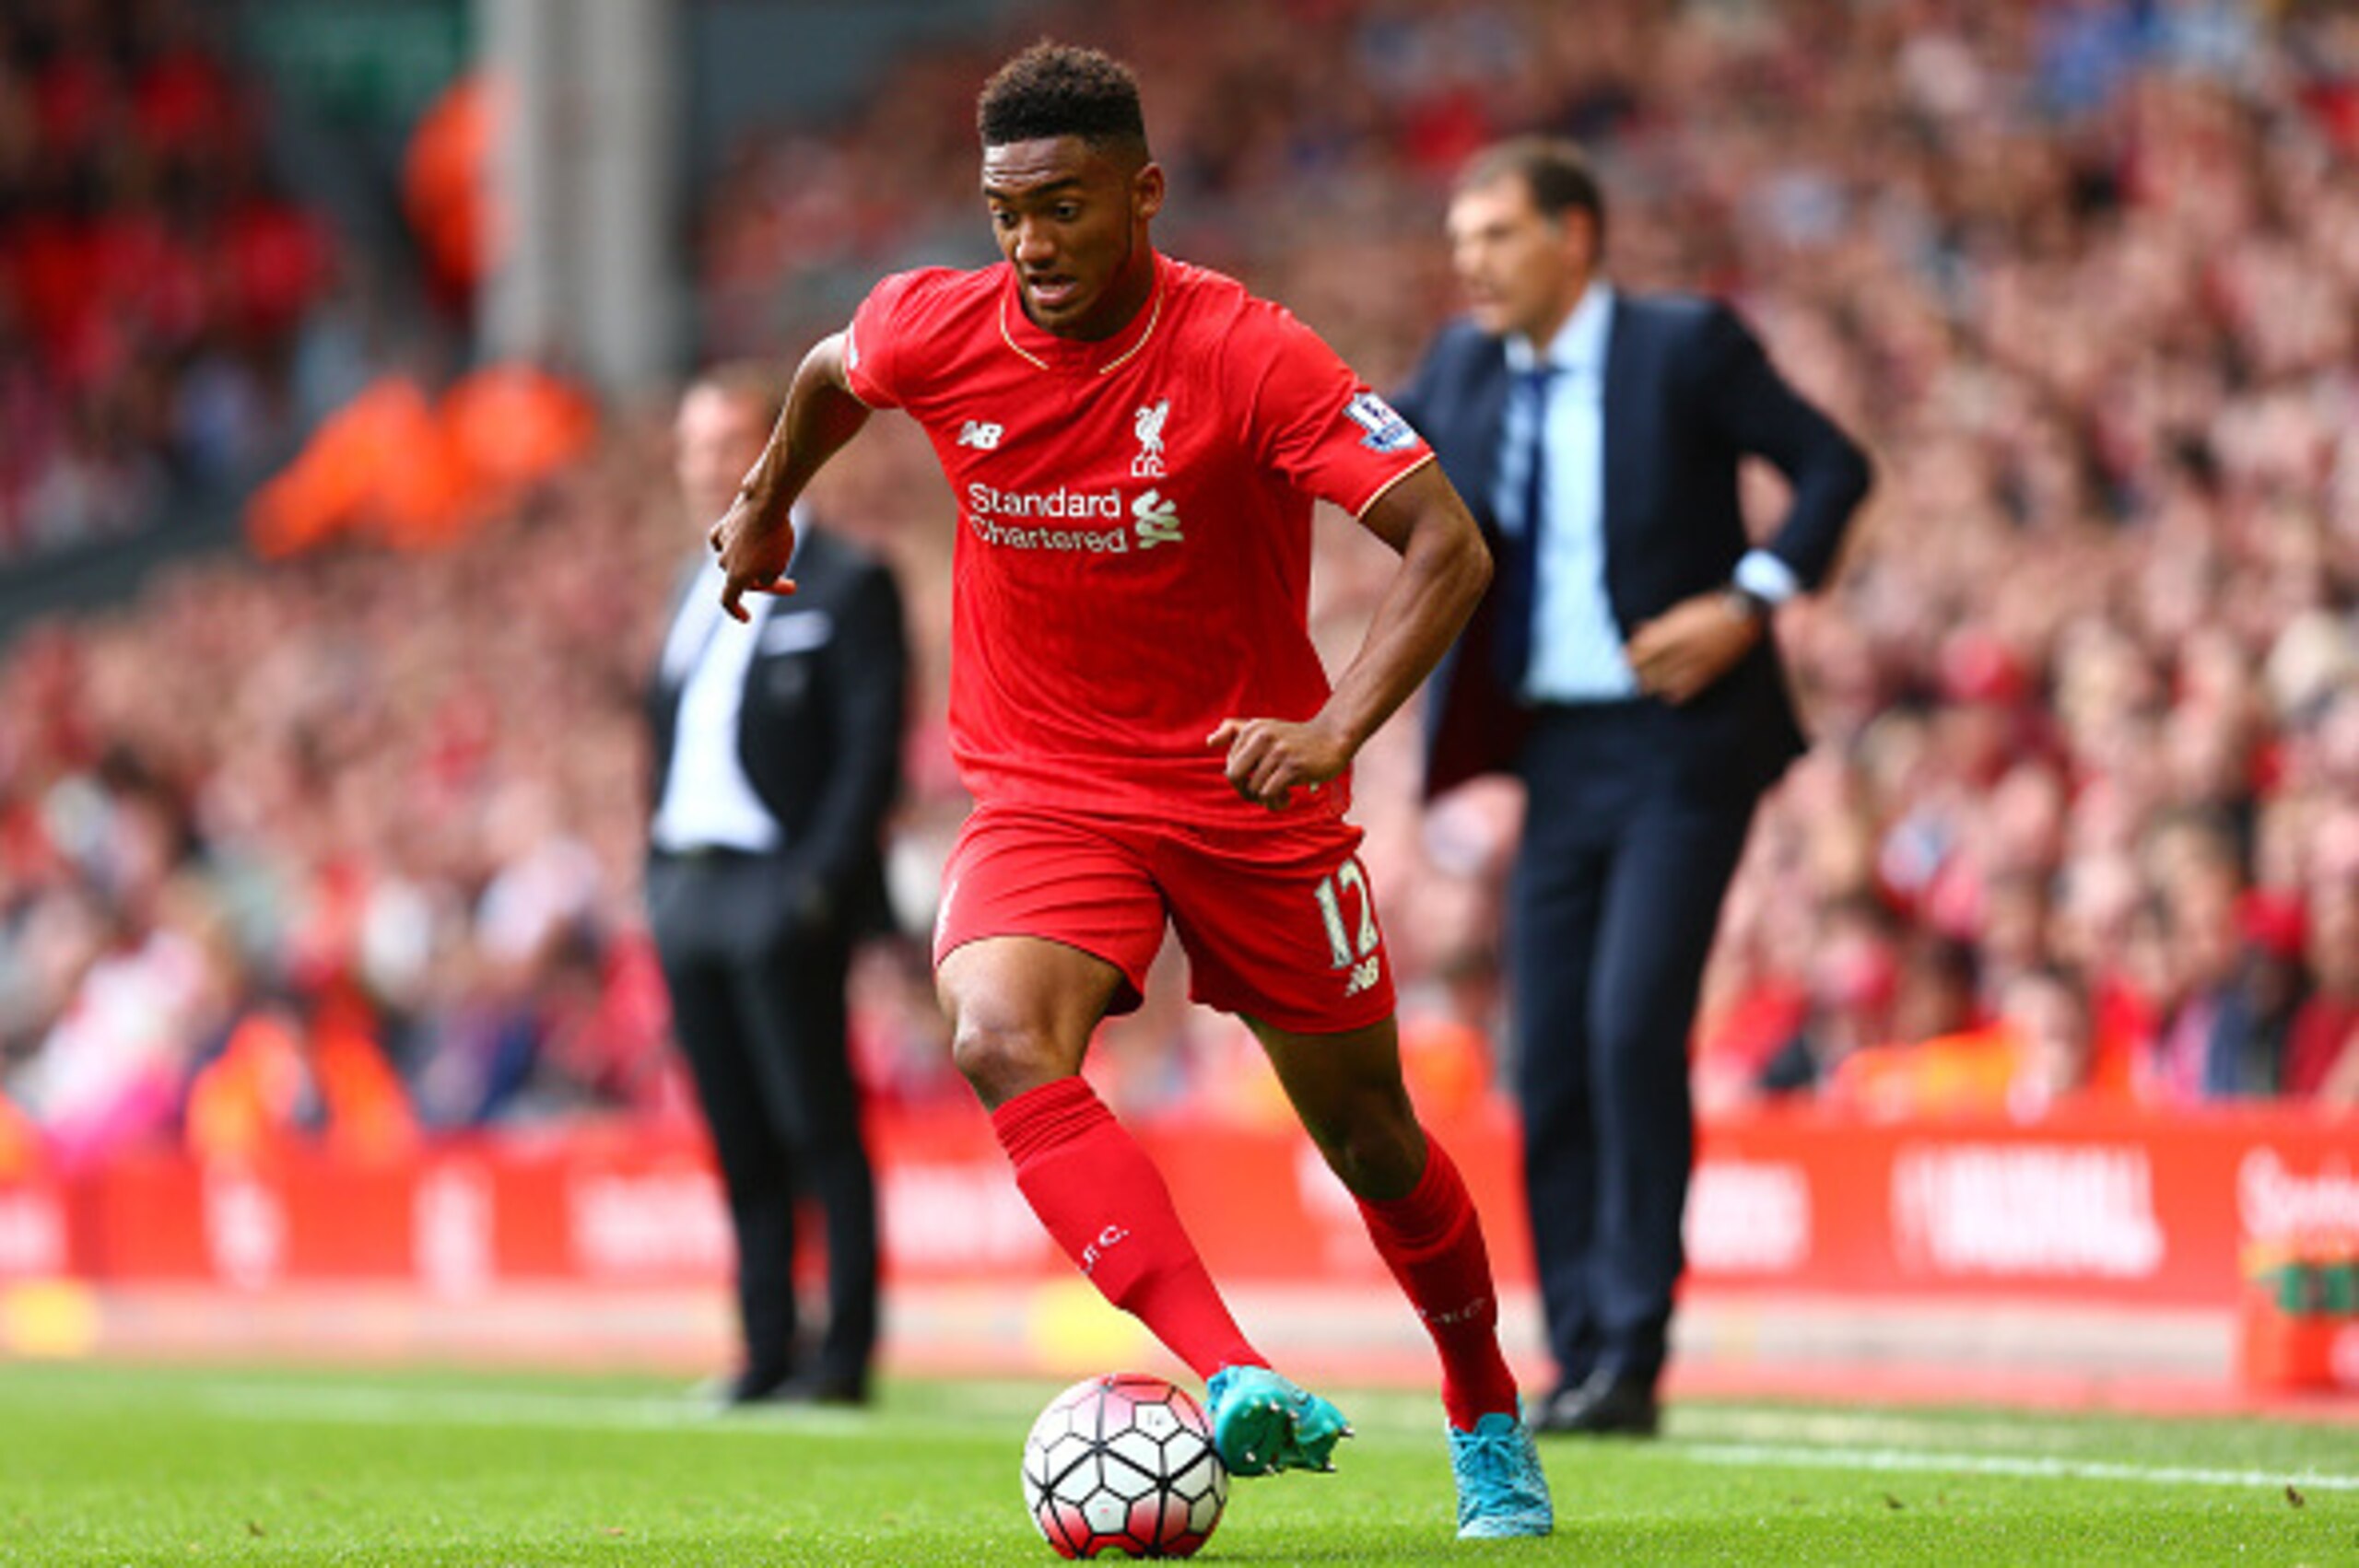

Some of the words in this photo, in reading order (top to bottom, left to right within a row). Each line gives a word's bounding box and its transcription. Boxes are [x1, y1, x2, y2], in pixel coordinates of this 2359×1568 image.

[968, 482, 1121, 518] Standard
[968, 514, 1128, 553] Chartered
[1313, 859, 1379, 970] 12
